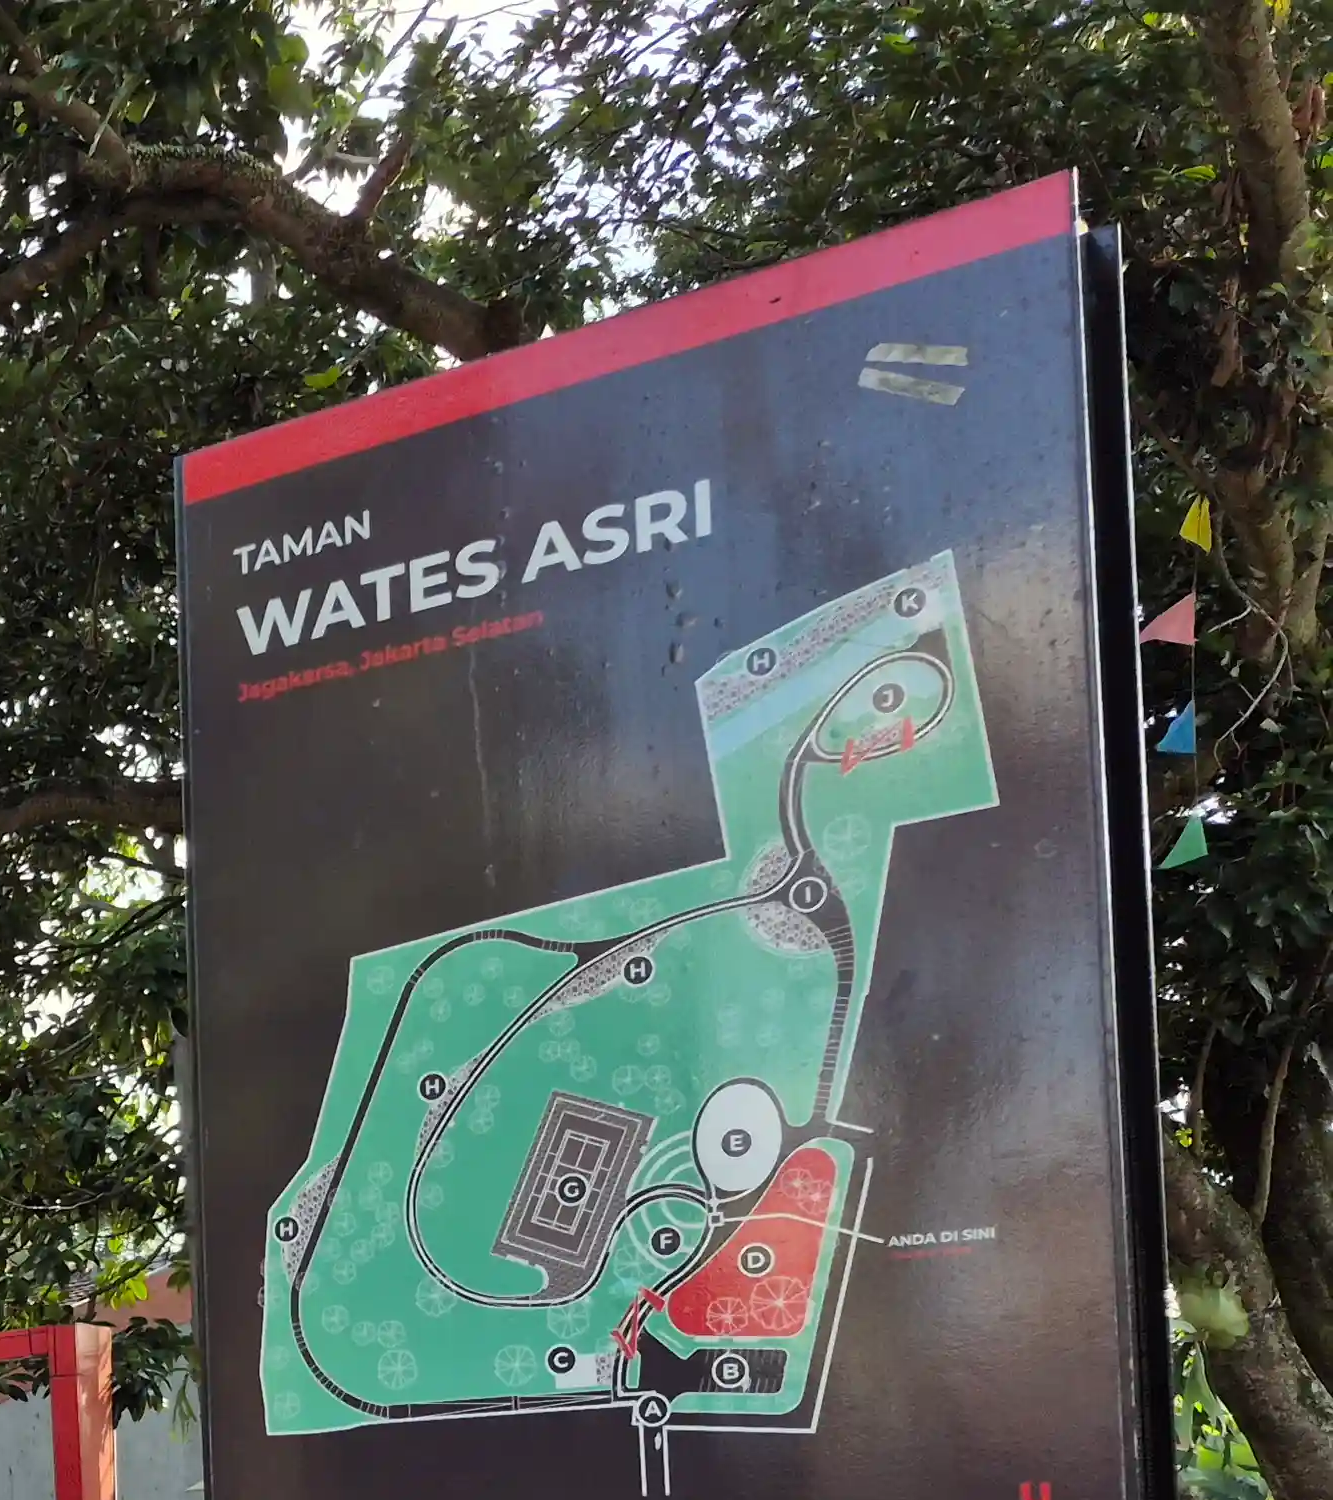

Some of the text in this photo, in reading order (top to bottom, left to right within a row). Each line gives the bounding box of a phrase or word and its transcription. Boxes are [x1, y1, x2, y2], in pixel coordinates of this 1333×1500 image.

[233, 509, 371, 574] TAMAN
[236, 479, 713, 656] WATES ASRI
[238, 609, 544, 702] Jagakarsa, Jakarta Selatan
[888, 1226, 996, 1247] ANDA DI SINI
